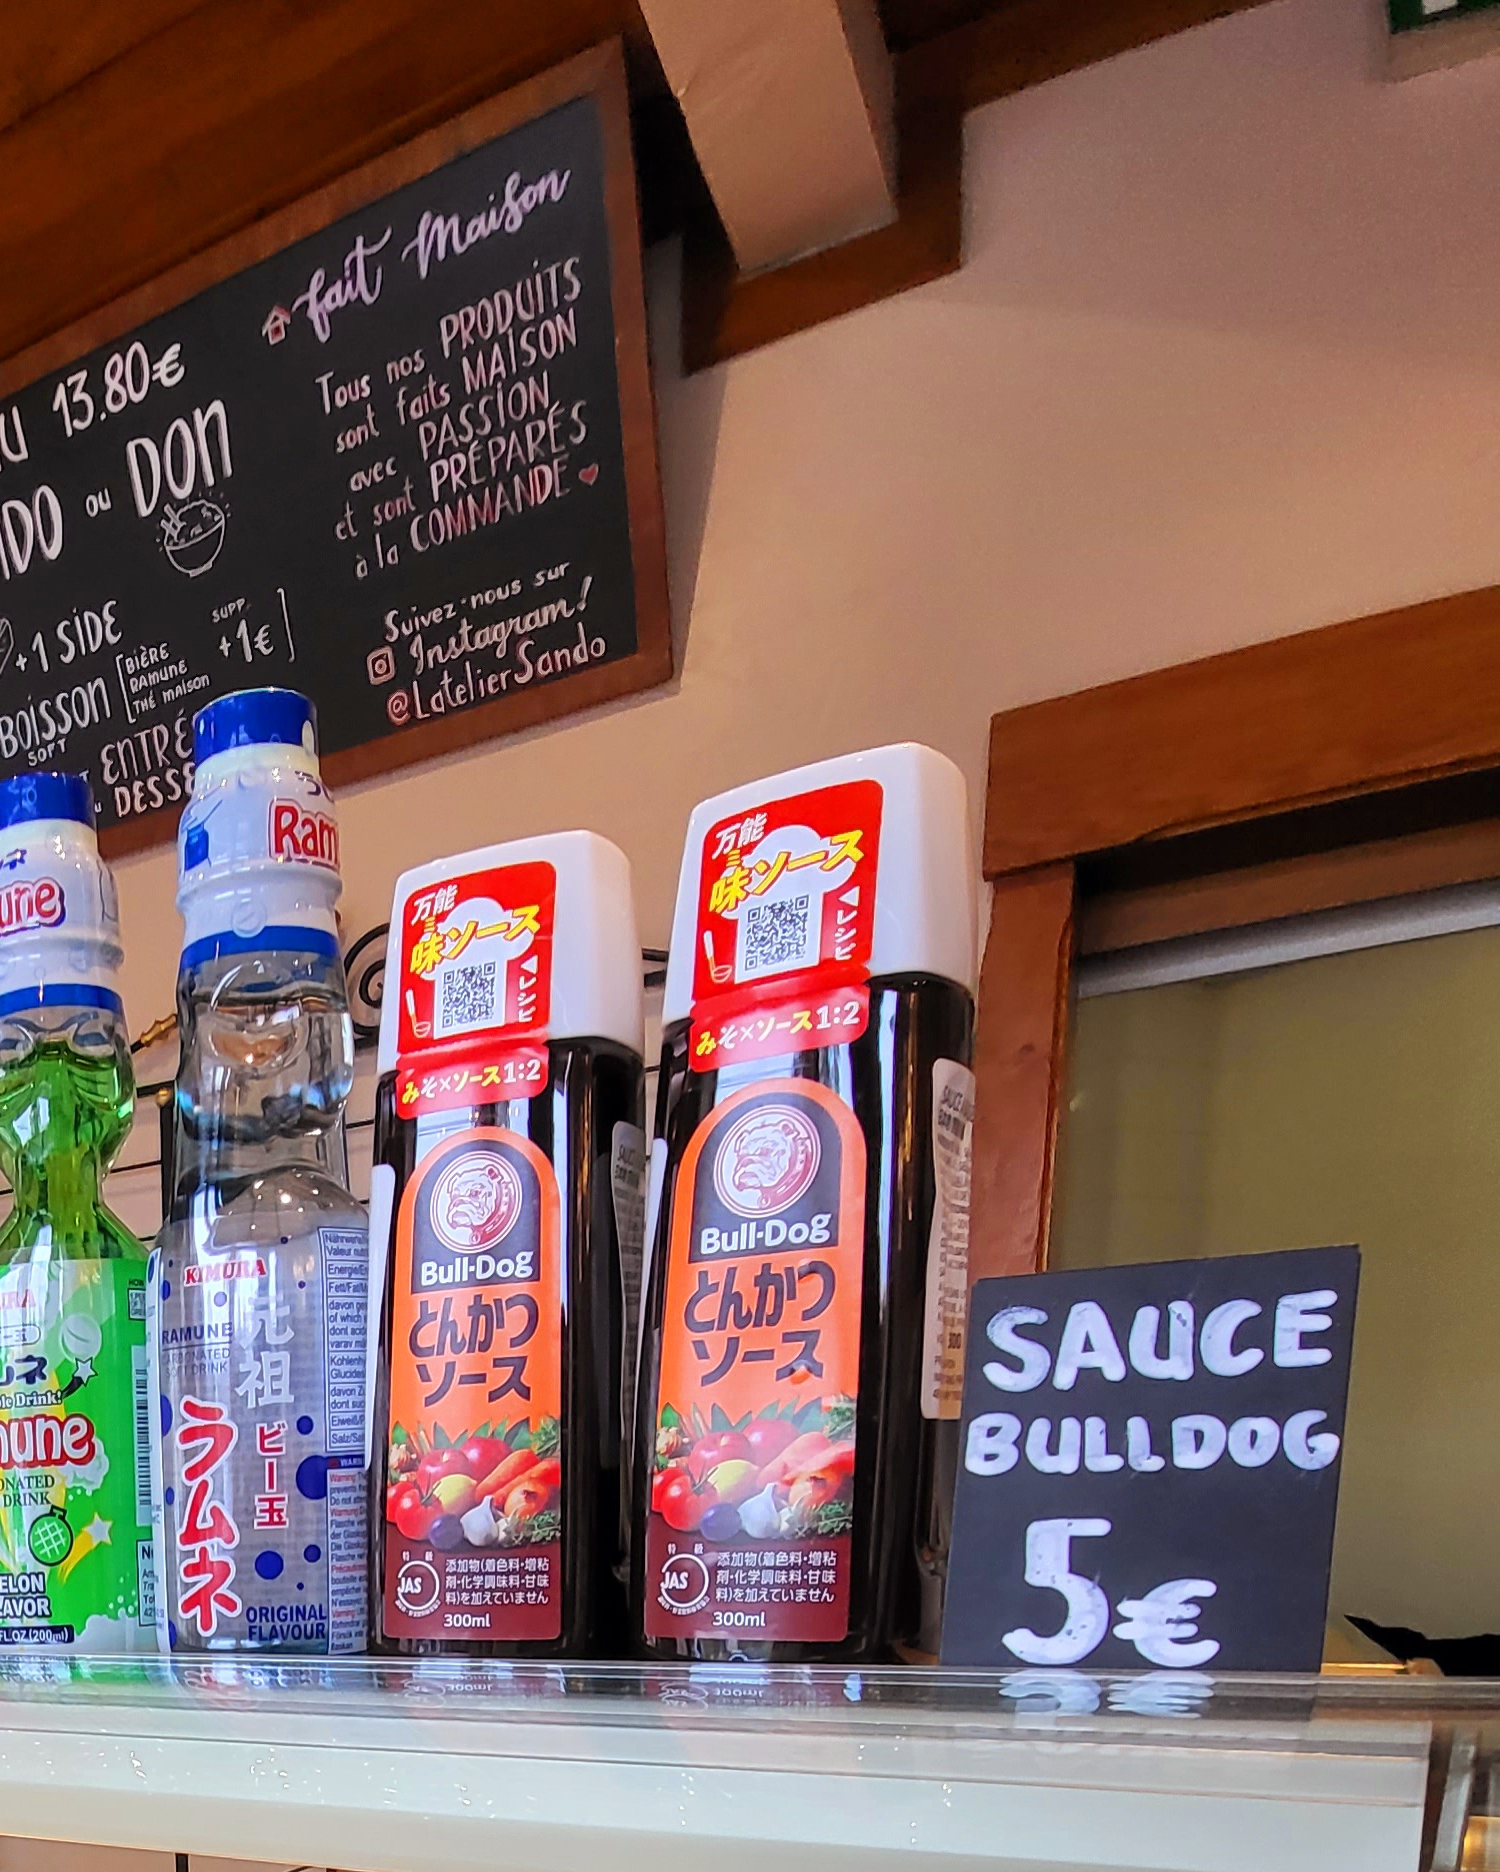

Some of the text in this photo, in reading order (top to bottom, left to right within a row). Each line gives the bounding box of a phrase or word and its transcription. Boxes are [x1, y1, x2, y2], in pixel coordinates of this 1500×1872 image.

[292, 168, 570, 343] fait Maison
[315, 257, 583, 416] Tous nos PRODUITS
[52, 342, 184, 438] 13.80€
[336, 308, 577, 453] sont faits MAISON
[349, 371, 550, 493] avec PASSION
[126, 400, 232, 517] DON
[336, 399, 587, 541] et sont PRÉPARÉS
[375, 533, 399, 569] la
[411, 454, 569, 552] COMMANDE
[535, 560, 570, 588] sur
[15, 600, 122, 672] +1 SIDE
[218, 619, 274, 663] +1€
[413, 576, 593, 675] Instagram!
[125, 642, 170, 675] BIÈRE
[130, 659, 188, 694] RAMUNE
[386, 635, 606, 727] @LatelierSando
[28, 738, 69, 767] SOFT
[712, 813, 767, 859] 万能
[411, 884, 458, 926] 万能
[834, 910, 857, 960] レシピ
[517, 976, 538, 1022] レシピ
[700, 1211, 832, 1254] Bull-Dog
[185, 1259, 266, 1285] KIMURA
[420, 1250, 533, 1287] Bull-Dog
[683, 1258, 836, 1331] とんかつ
[162, 1322, 232, 1345] RAMUNE
[410, 1295, 539, 1357] とんかつ
[982, 1289, 1339, 1393] SAUCE
[416, 1356, 531, 1407] ソース
[691, 1328, 825, 1387] ソース
[965, 1409, 1341, 1476] BULLDOG
[3, 1492, 50, 1507] DRINK
[178, 1395, 242, 1638] ラムネ
[398, 1577, 422, 1593] JAS
[660, 1571, 688, 1589] JAS
[1002, 1517, 1221, 1668] 5€
[246, 1603, 326, 1623] ORIGINAL
[248, 1622, 326, 1643] FLAVOUR
[443, 1614, 490, 1628] 300ml
[712, 1611, 766, 1627] 300ml
